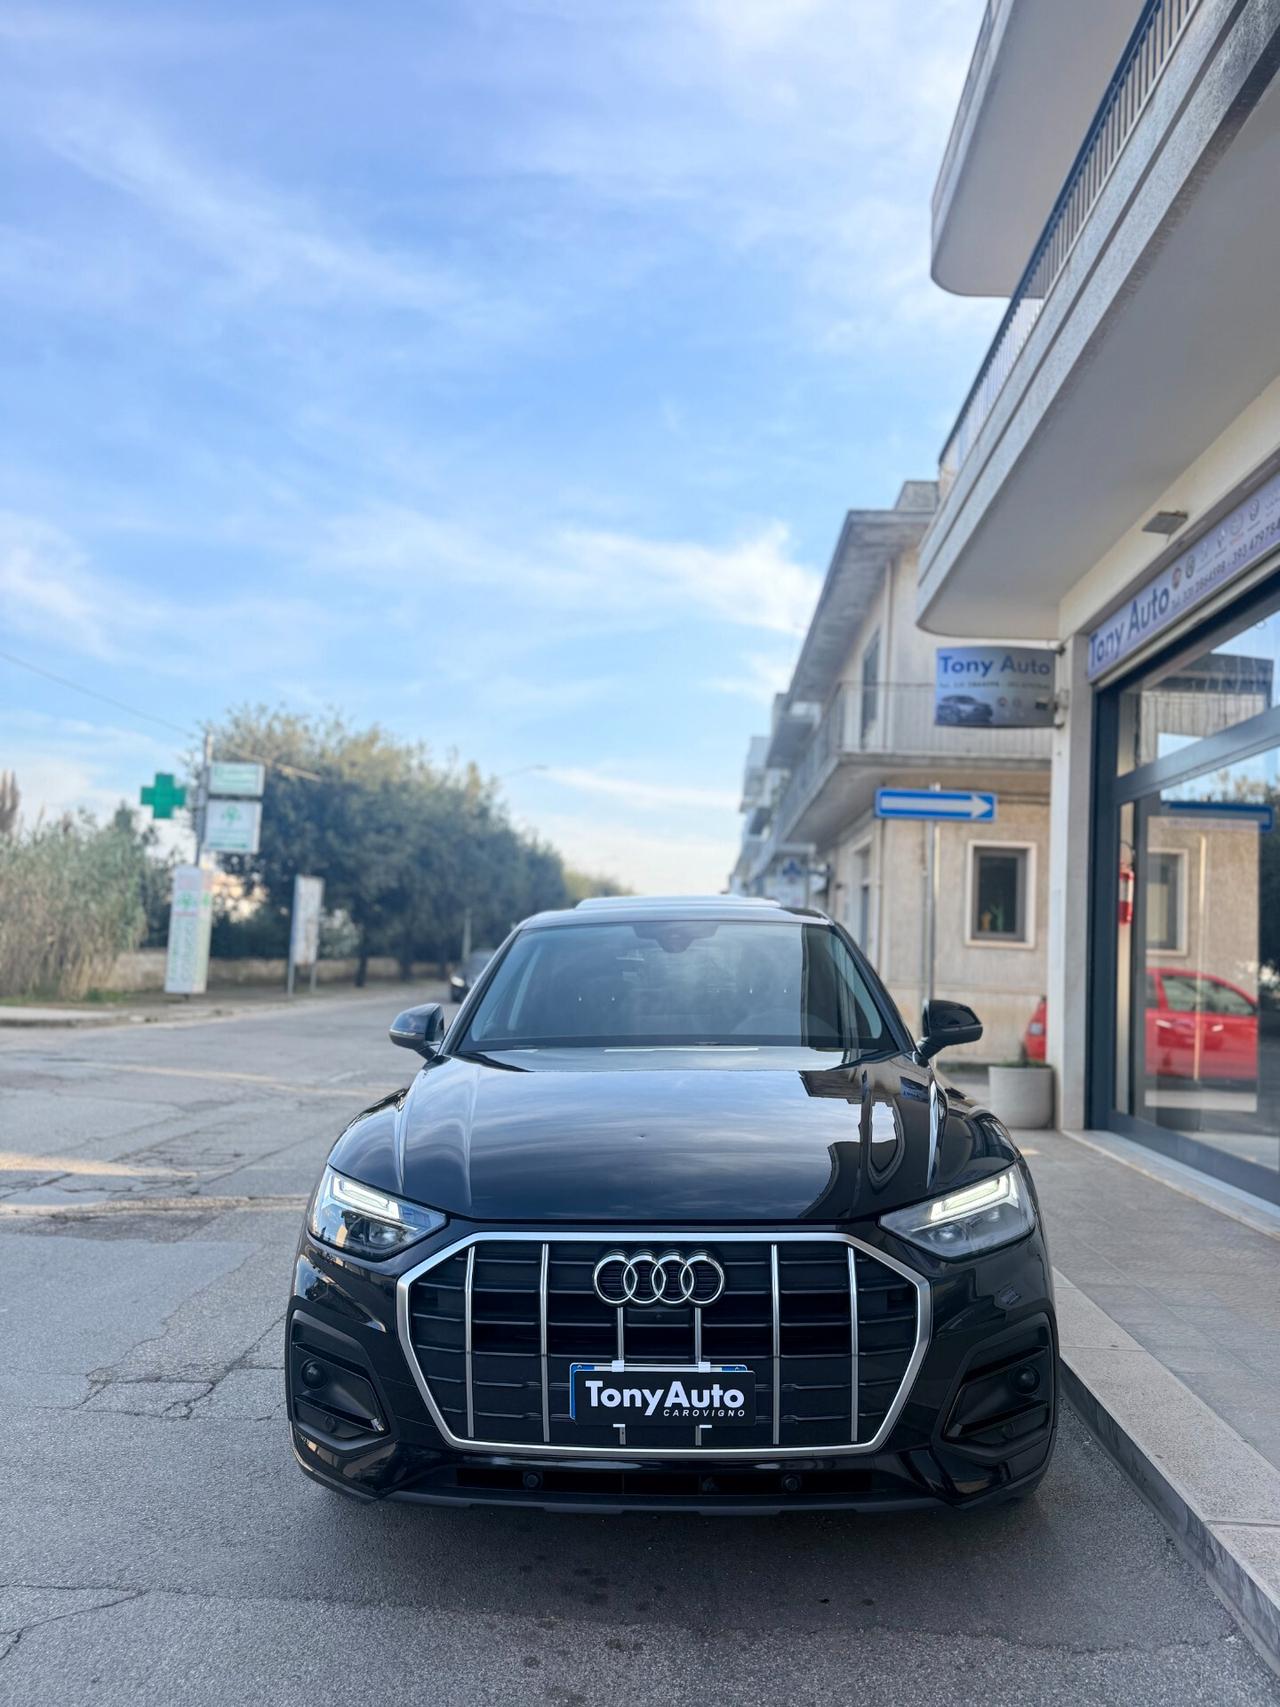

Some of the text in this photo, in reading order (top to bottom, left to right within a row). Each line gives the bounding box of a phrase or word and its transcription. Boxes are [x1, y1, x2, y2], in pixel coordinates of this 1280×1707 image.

[1089, 587, 1170, 668] Tony Auto
[940, 655, 1051, 678] Tony Auto
[585, 1380, 745, 1416] TonyAuto
[663, 1409, 746, 1417] CAROVIGNO
